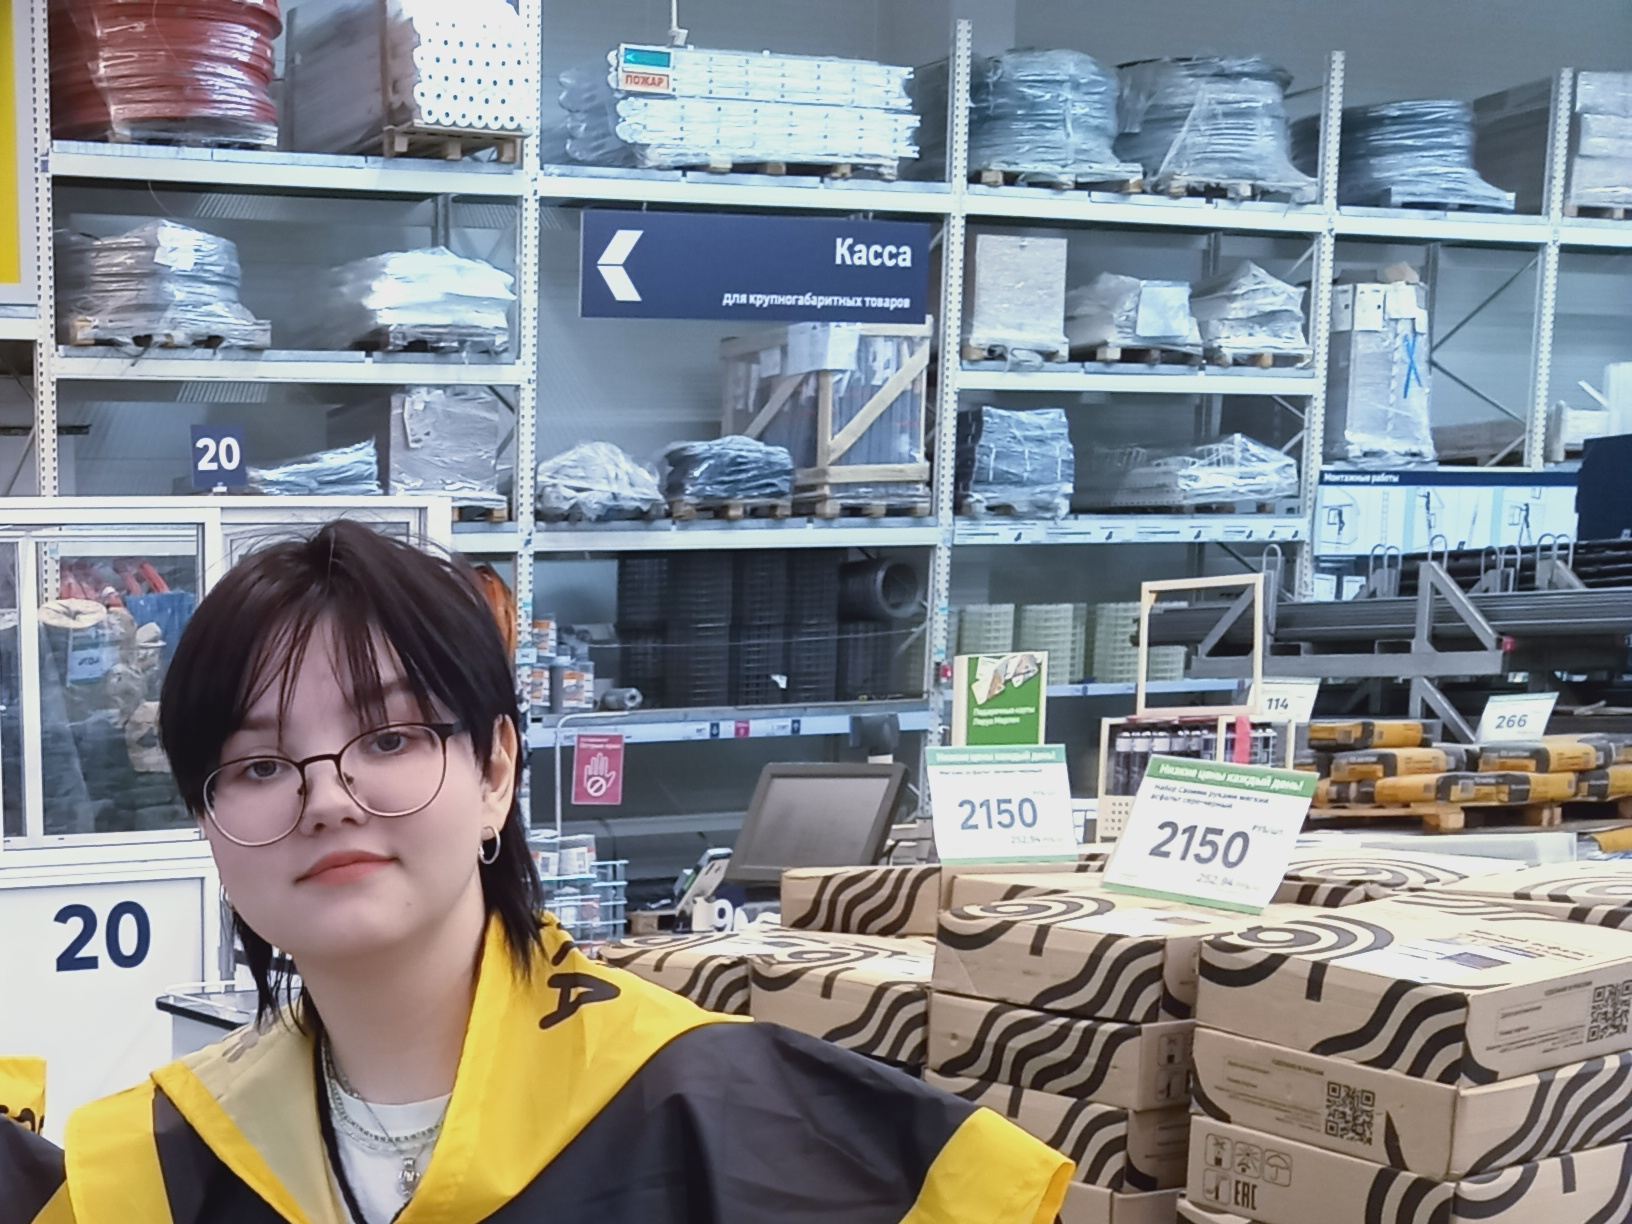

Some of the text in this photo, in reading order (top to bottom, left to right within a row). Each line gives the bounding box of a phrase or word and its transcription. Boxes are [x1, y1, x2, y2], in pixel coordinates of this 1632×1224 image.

[624, 74, 665, 89] ПОЖАР
[835, 237, 912, 268] Касса
[722, 292, 910, 311] для крупногабаритных товаров
[195, 435, 241, 472] 20
[1267, 698, 1288, 710] 114
[1495, 715, 1526, 729] 266
[958, 797, 1038, 831] 2150
[1148, 820, 1250, 869] 2150
[52, 900, 151, 972] 20
